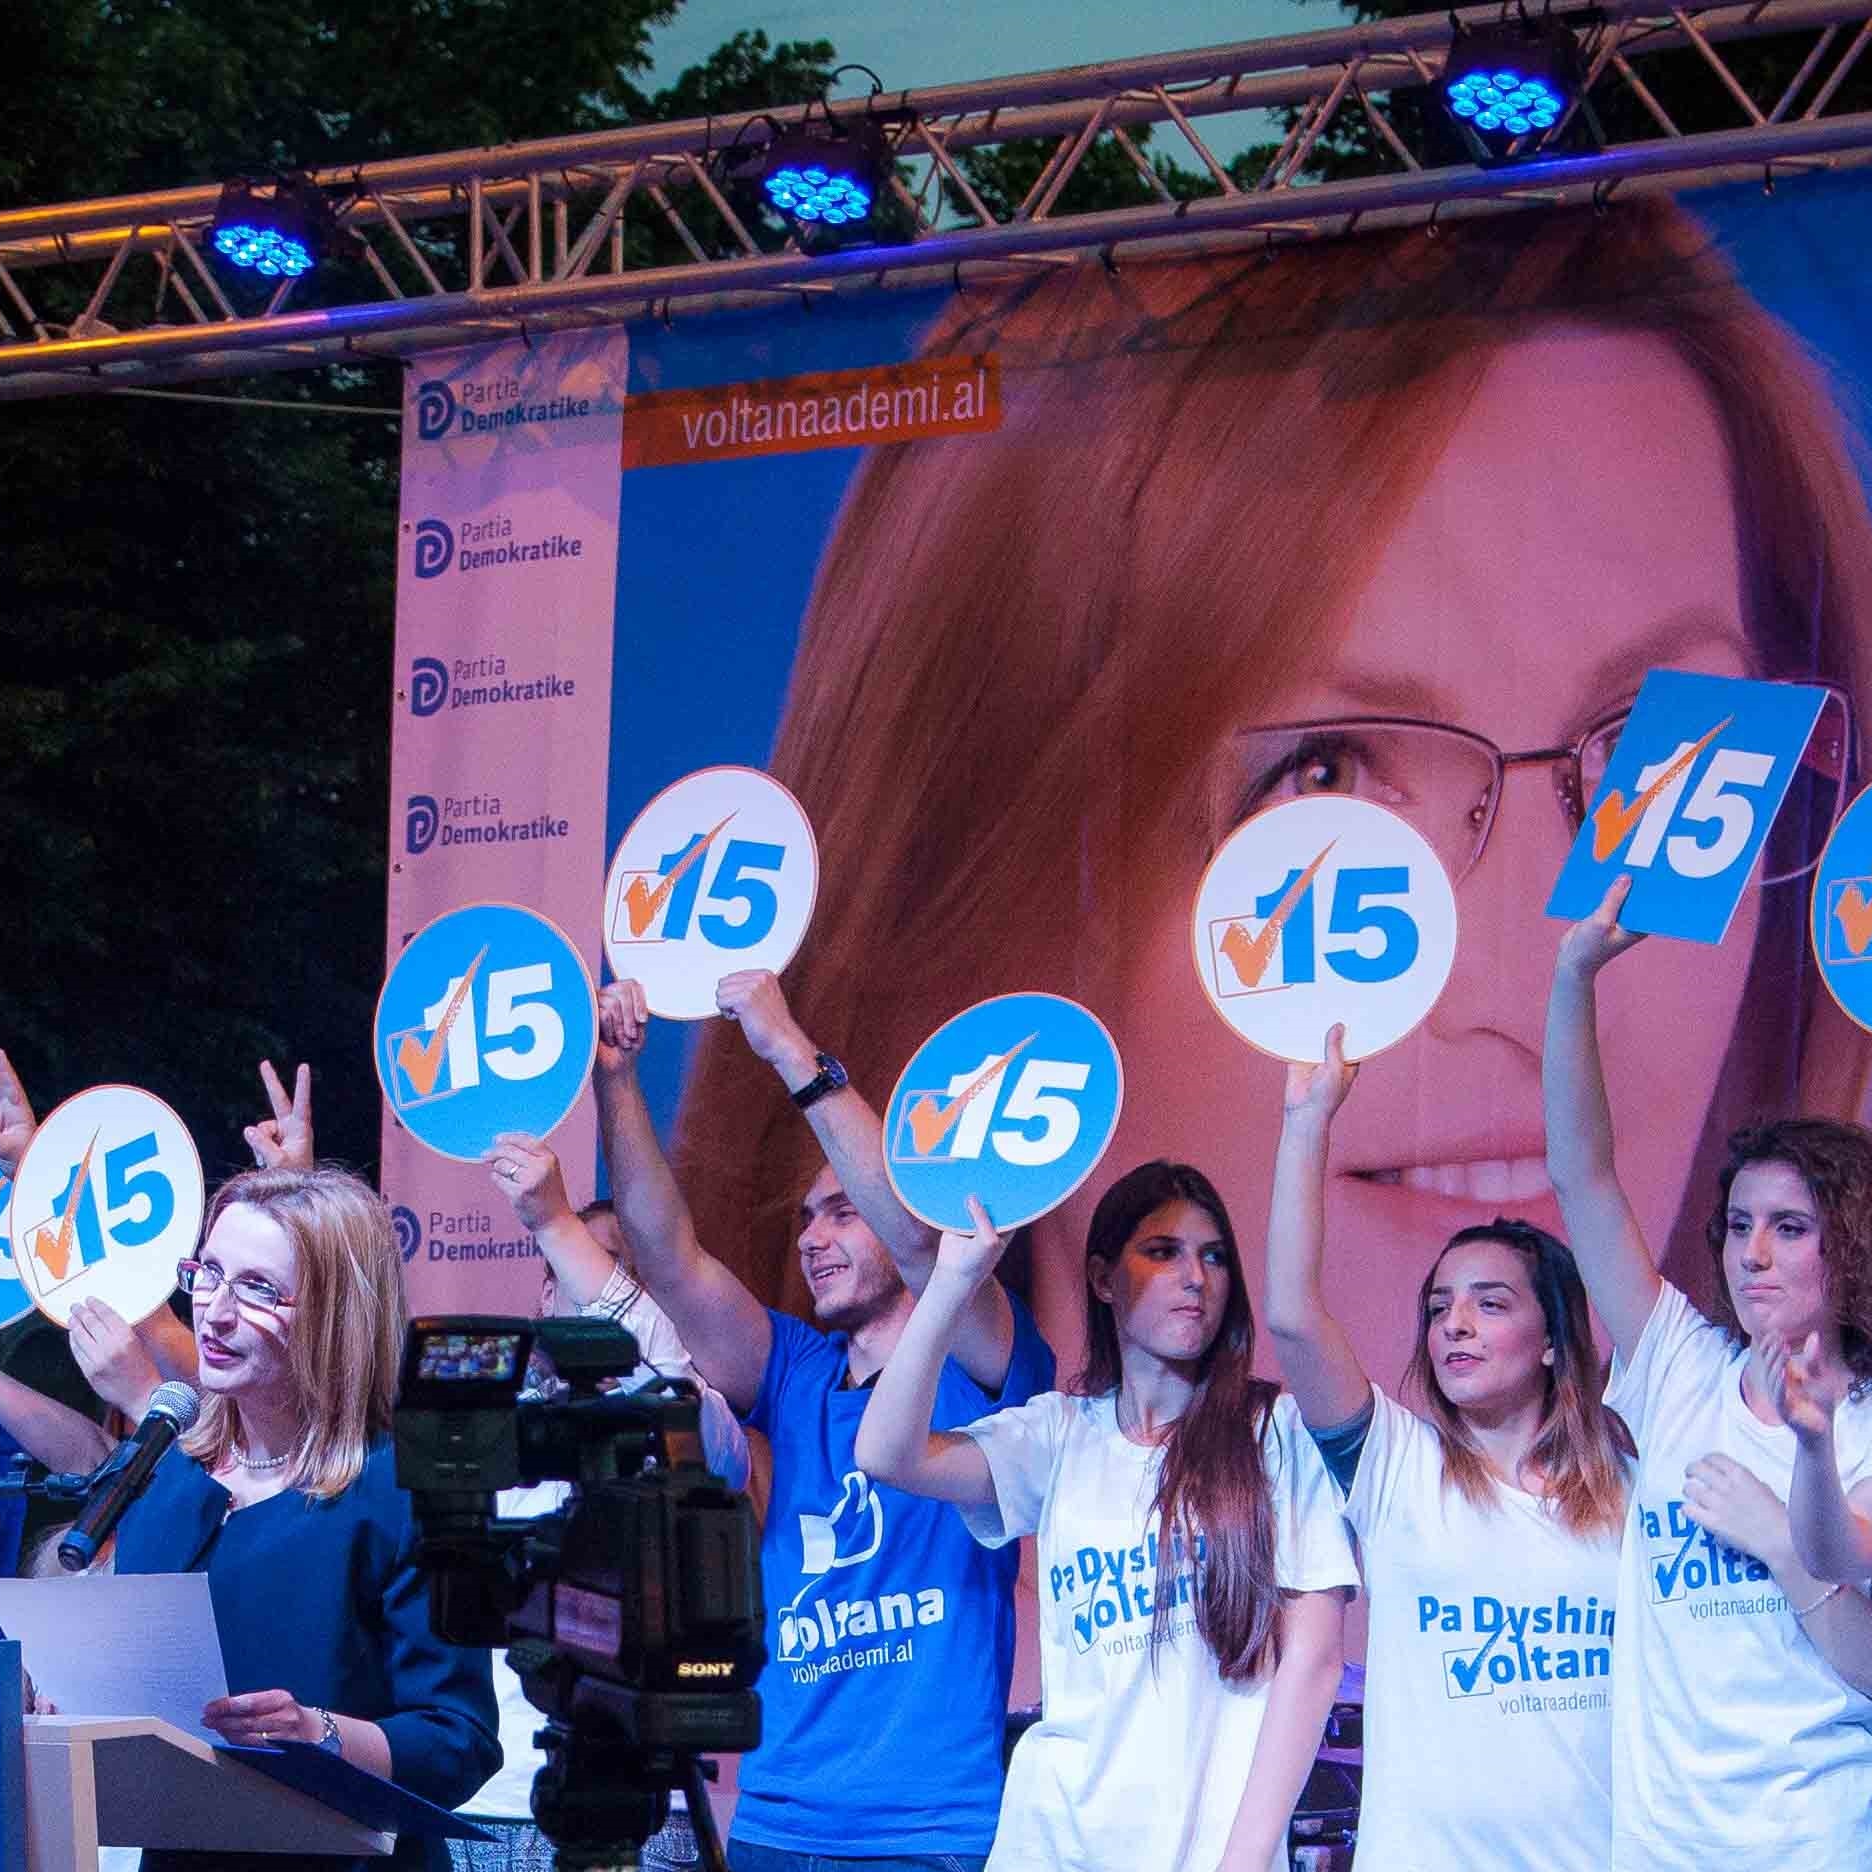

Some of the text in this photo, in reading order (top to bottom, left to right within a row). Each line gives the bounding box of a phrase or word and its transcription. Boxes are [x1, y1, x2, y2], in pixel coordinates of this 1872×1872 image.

[462, 376, 520, 404] Partia
[462, 396, 590, 433] Demokratike
[682, 368, 986, 450] voltanaademi.al
[460, 514, 513, 543] Partia
[459, 534, 584, 571] Demokratike
[454, 653, 506, 681] Partia
[450, 674, 576, 710] Demokratike
[444, 793, 501, 819] Partia
[1622, 741, 1776, 880] 15
[440, 814, 569, 846] Demokratike
[656, 830, 788, 951] 15
[1254, 863, 1420, 985] 15
[423, 961, 566, 1090] 15
[946, 1052, 1094, 1168] 15
[49, 1130, 178, 1267] 15
[429, 1211, 491, 1234] Partia
[428, 1234, 543, 1263] Demokratik
[1417, 1595, 1462, 1633] Pa
[677, 1661, 735, 1678] SONY
[1449, 1636, 1611, 1693] Voltan
